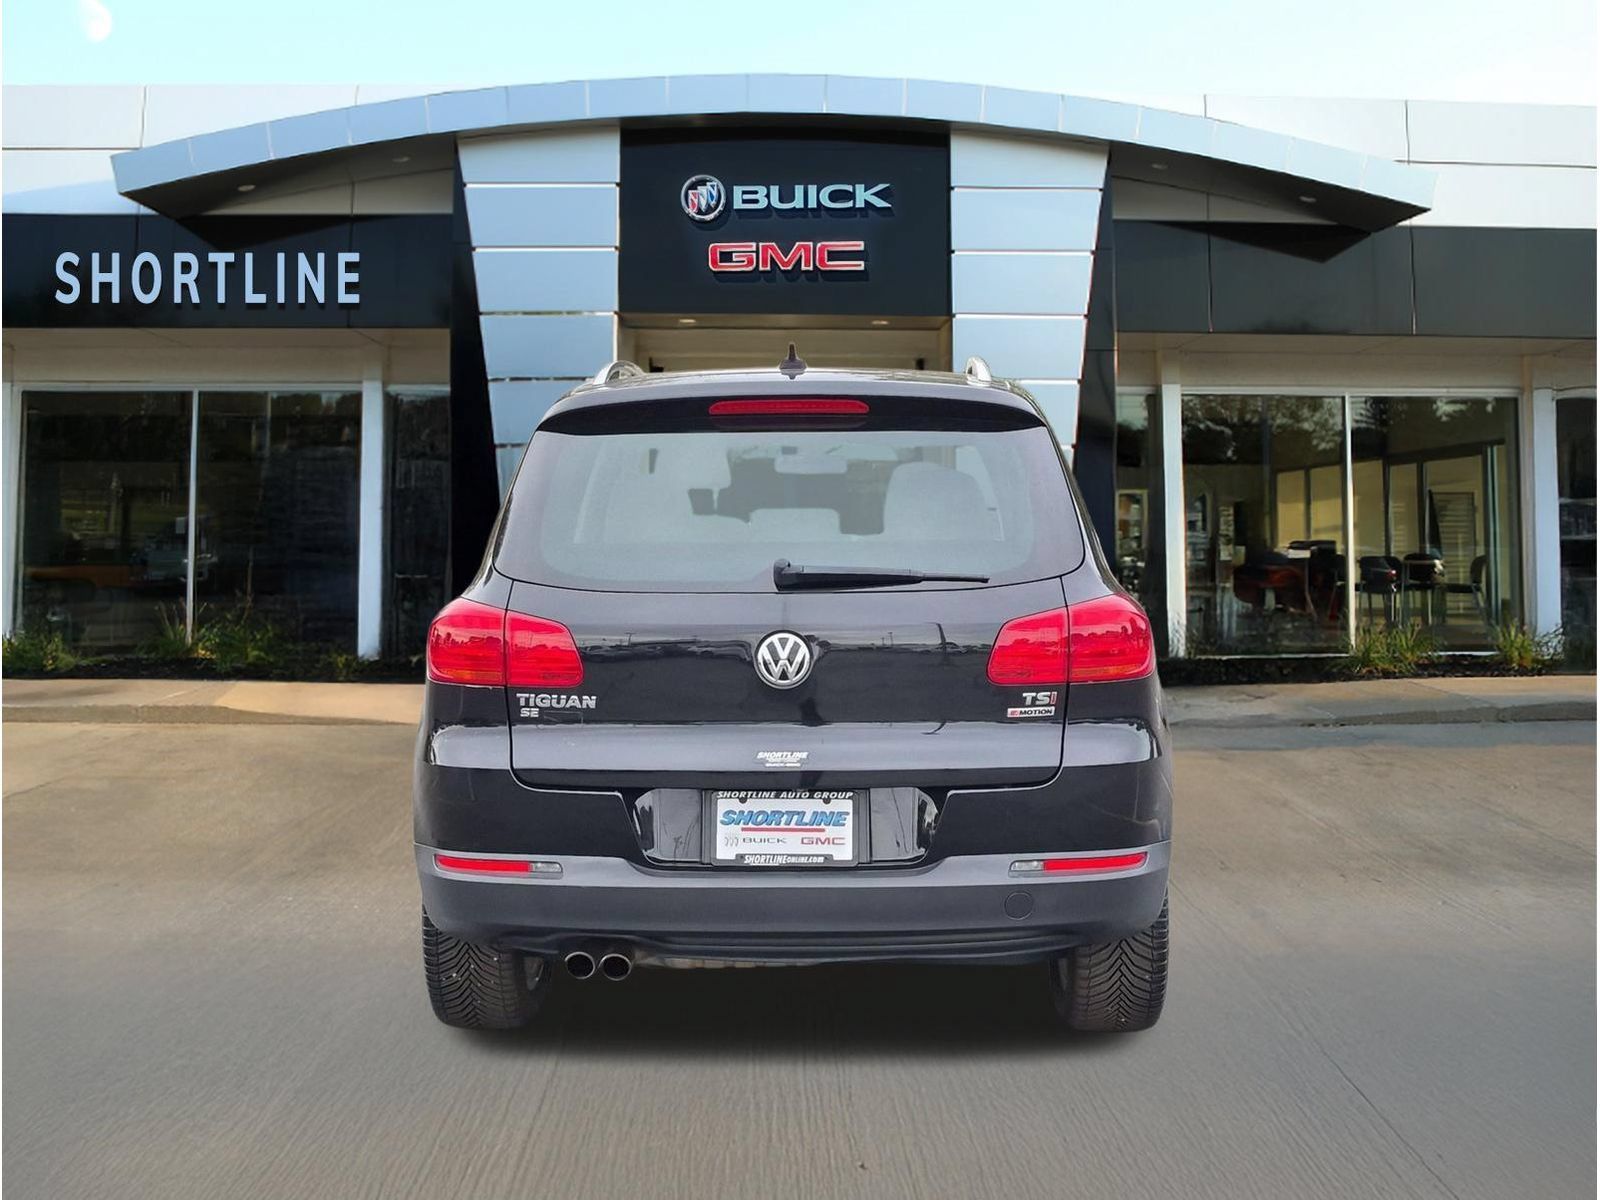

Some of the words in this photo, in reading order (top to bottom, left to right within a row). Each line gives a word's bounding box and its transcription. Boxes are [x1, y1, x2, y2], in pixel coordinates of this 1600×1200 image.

[733, 183, 892, 210] BUICK
[708, 240, 865, 272] GMC
[55, 251, 361, 305] SHORTLINE
[516, 693, 597, 709] TIGUAN
[520, 708, 540, 718] SE
[716, 791, 776, 799] SHORTLINE
[779, 791, 810, 799] AUTO
[814, 791, 853, 799] GROUP
[720, 809, 851, 827] SHORTLINE
[742, 836, 788, 845] BUICK
[800, 836, 846, 846] GMC
